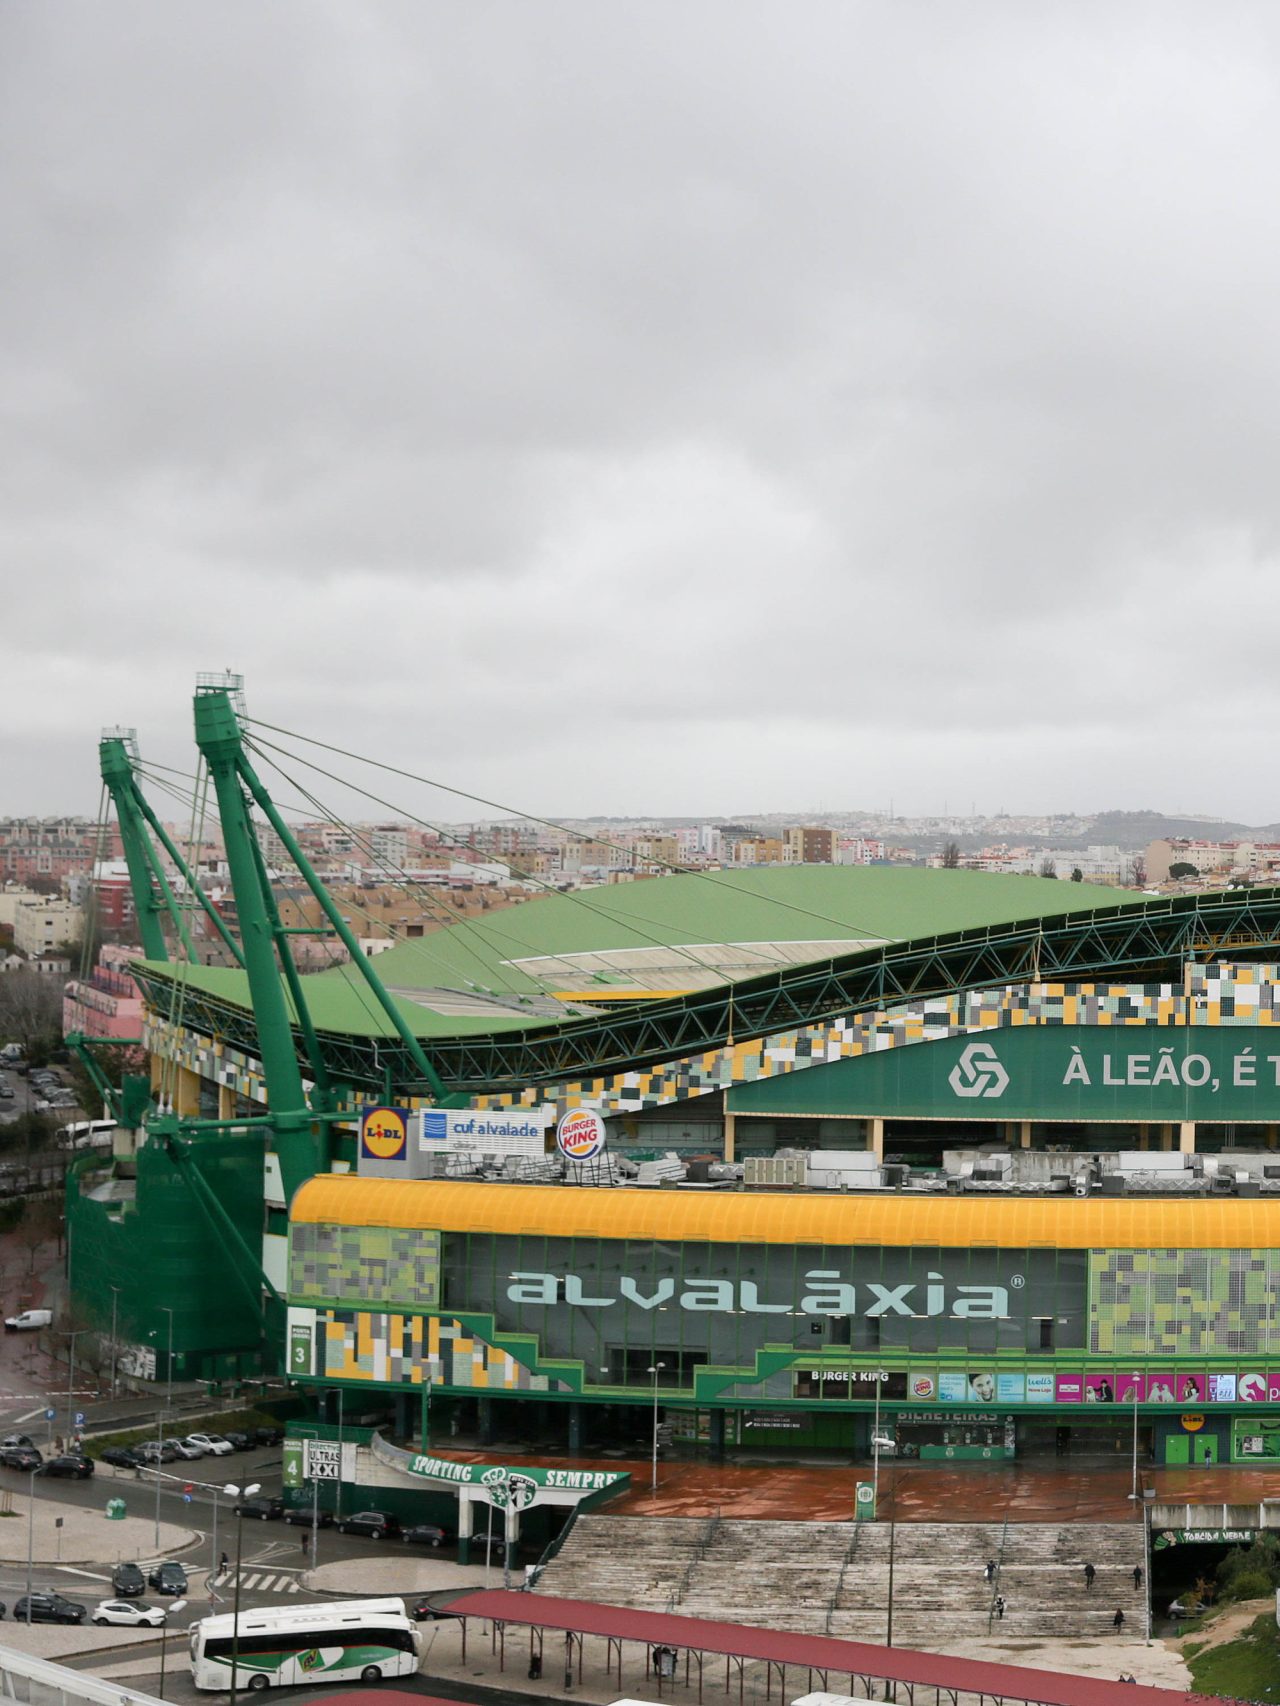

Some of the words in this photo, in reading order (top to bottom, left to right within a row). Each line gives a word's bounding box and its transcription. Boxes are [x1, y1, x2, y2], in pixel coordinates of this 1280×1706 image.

[1062, 1045, 1091, 1086] À
[1102, 1046, 1220, 1093] LEÃO,
[1232, 1046, 1257, 1088] É
[453, 1119, 475, 1134] cuf
[477, 1120, 538, 1137] alvalade
[562, 1118, 596, 1136] BURGER
[563, 1130, 598, 1150] KING
[295, 1347, 305, 1363] 3
[811, 1371, 857, 1381] BURGER
[859, 1372, 889, 1382] KING
[76, 1413, 84, 1424] P
[310, 1451, 340, 1462] ULTRAS
[288, 1460, 297, 1475] 4
[311, 1463, 339, 1476] XXI
[413, 1455, 472, 1481] SPORTING
[546, 1470, 617, 1489] SEMPRE
[1223, 1531, 1251, 1540] VERDE
